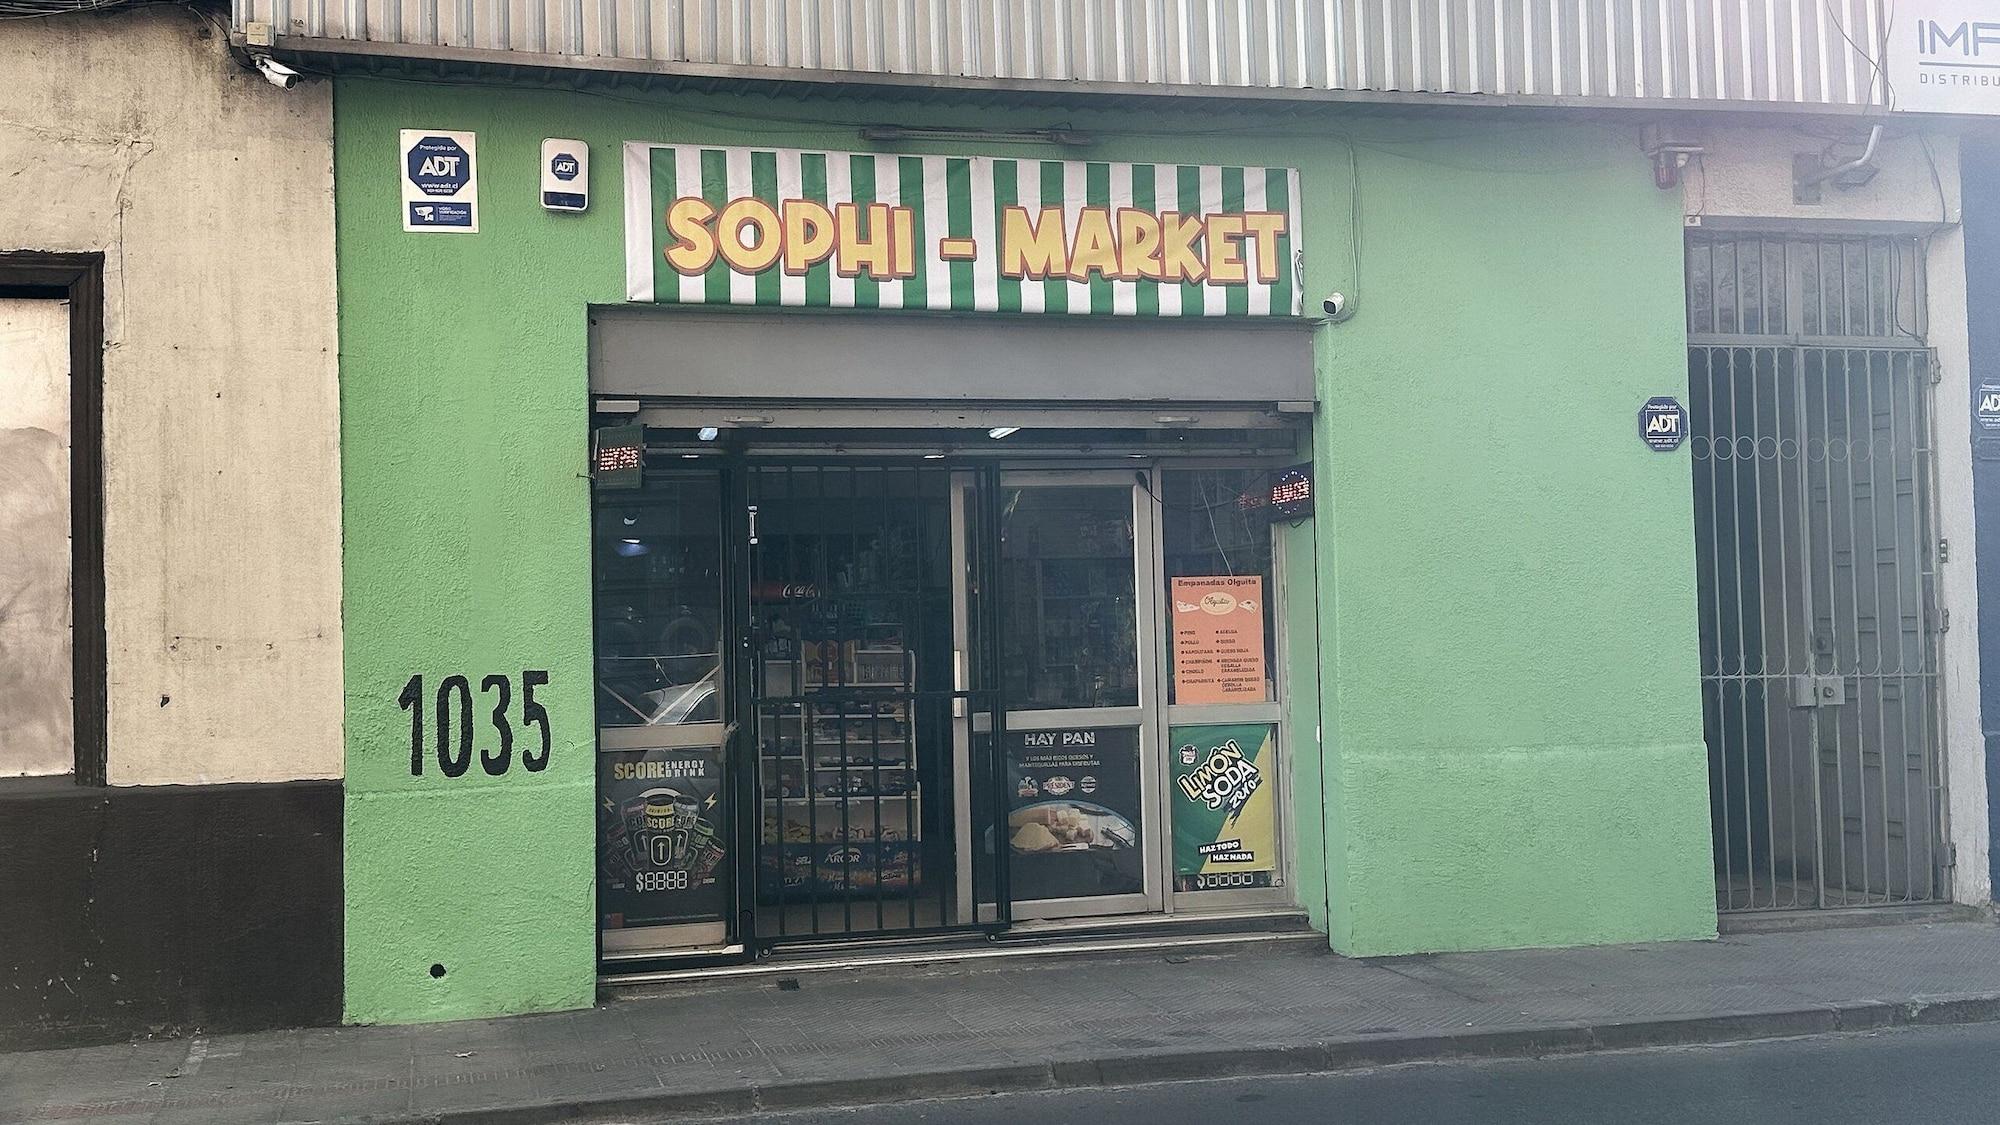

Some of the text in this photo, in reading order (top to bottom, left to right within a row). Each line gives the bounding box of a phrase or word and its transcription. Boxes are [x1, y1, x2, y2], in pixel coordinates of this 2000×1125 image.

[418, 156, 460, 176] ADT
[556, 162, 575, 172] ADT
[664, 196, 916, 281] SOPHI
[1000, 205, 1287, 287] MARKET
[1648, 414, 1679, 432] ADT
[398, 671, 551, 778] 1035
[1024, 731, 1096, 745] HAY PAN
[614, 761, 665, 780] SCORE
[665, 760, 705, 769] ENERGY
[665, 768, 705, 778] DRINK
[1178, 739, 1244, 801] LIMÓN
[1203, 759, 1258, 809] SODA
[1200, 841, 1240, 853] HAZ TODO
[1213, 852, 1253, 861] HAZ NADA
[636, 870, 688, 892] $8888
